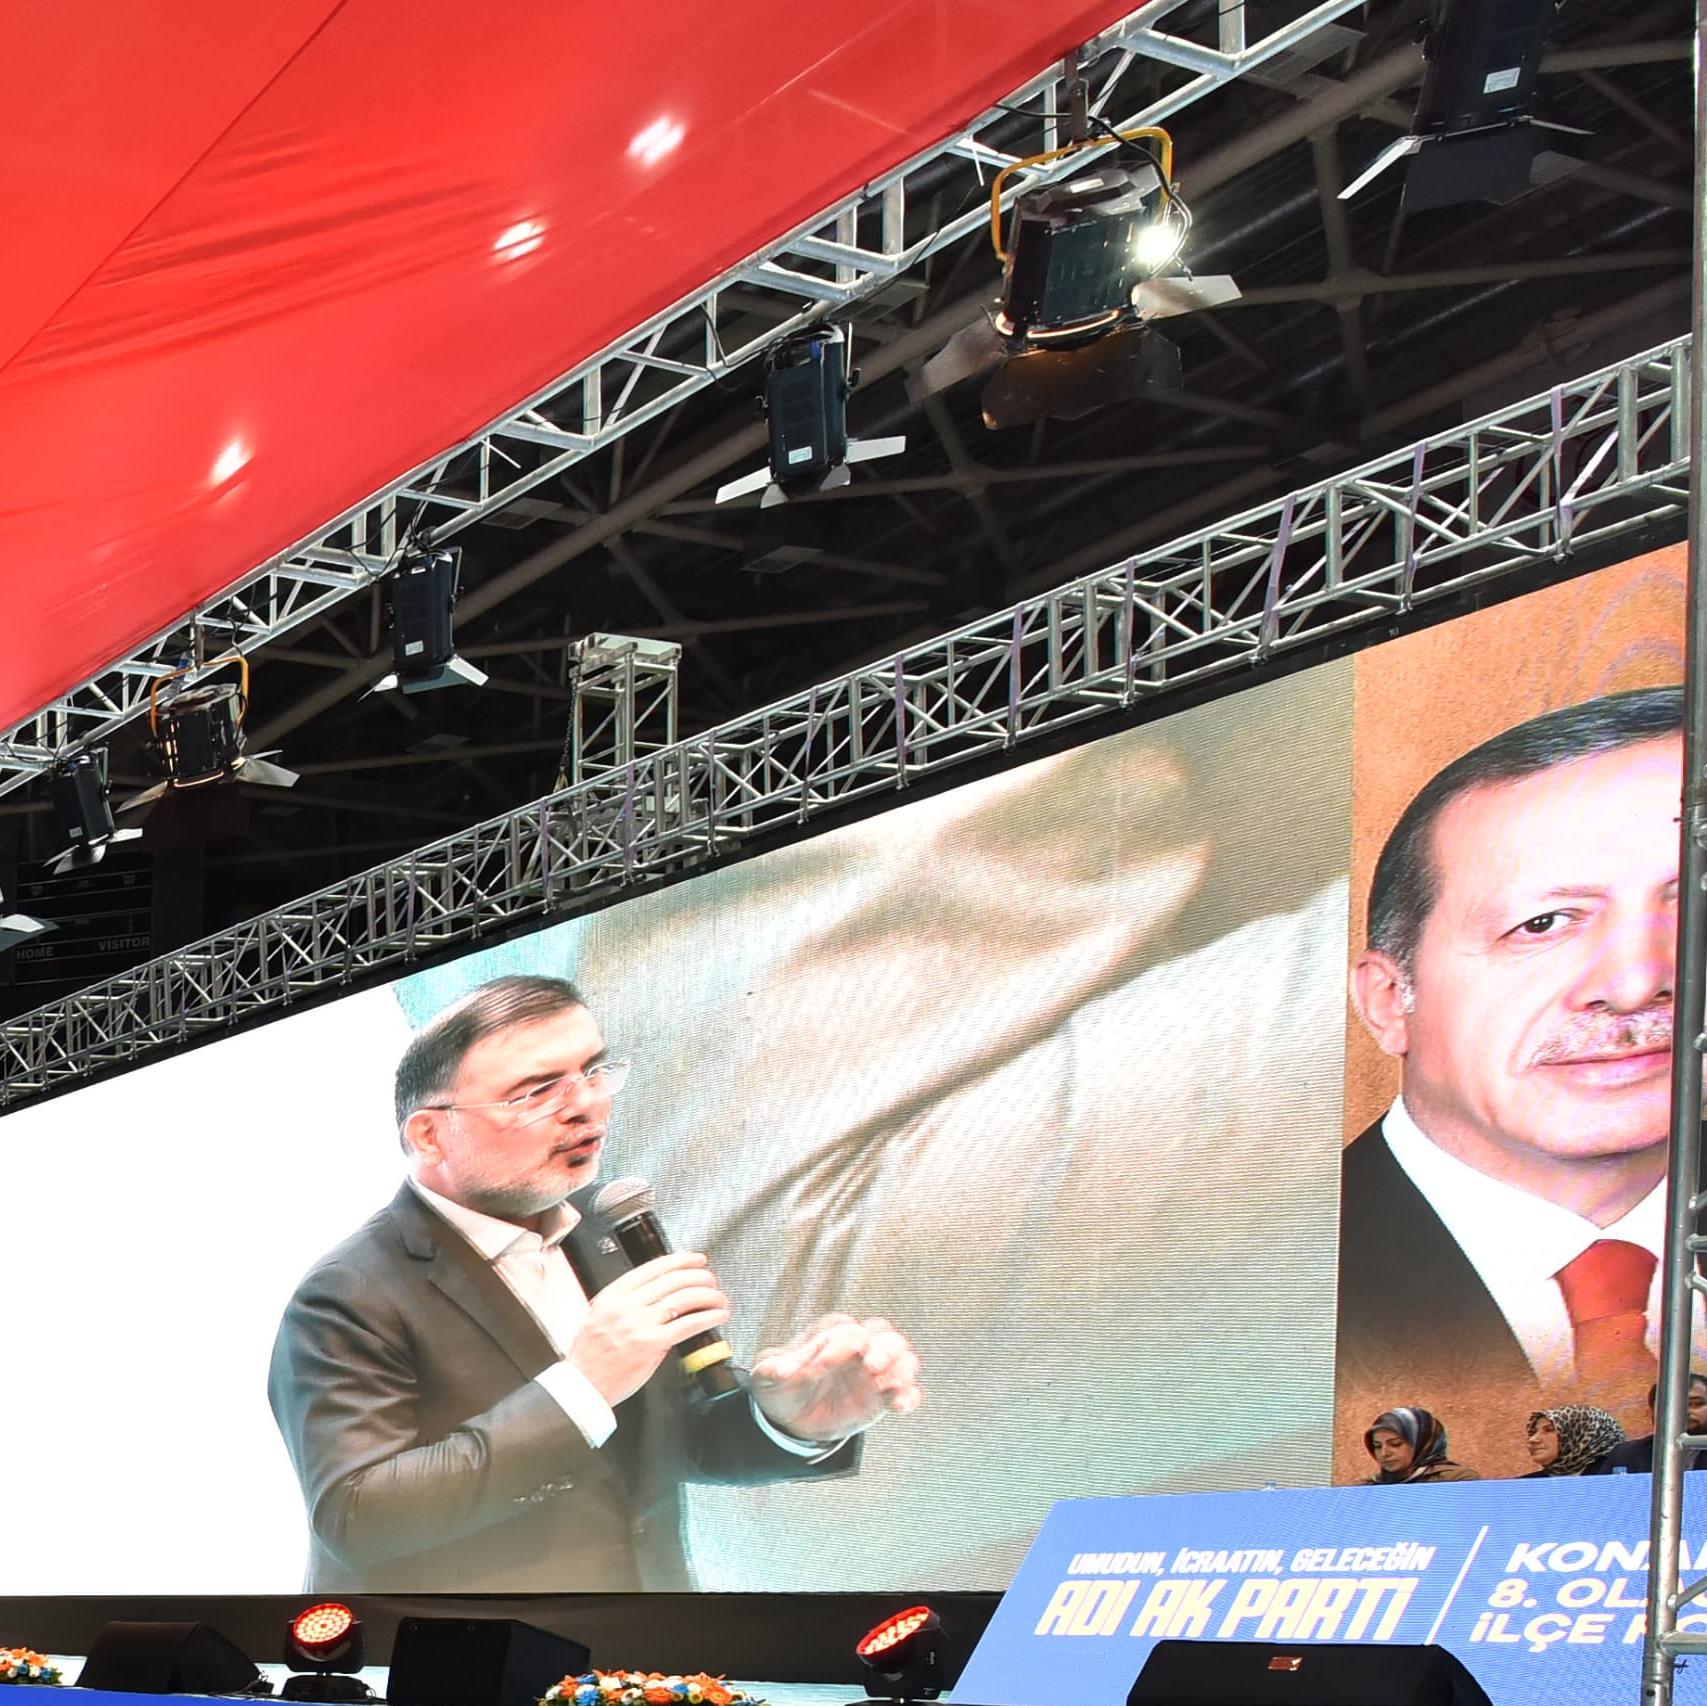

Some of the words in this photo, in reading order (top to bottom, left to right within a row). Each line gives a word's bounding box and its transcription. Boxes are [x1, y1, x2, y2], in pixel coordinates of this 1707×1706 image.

[16, 946, 55, 960] HOME
[98, 936, 150, 951] VISITOR
[1488, 1578, 1537, 1608] 8.
[1034, 1579, 1142, 1636] ADI
[1129, 1579, 1228, 1638] AK
